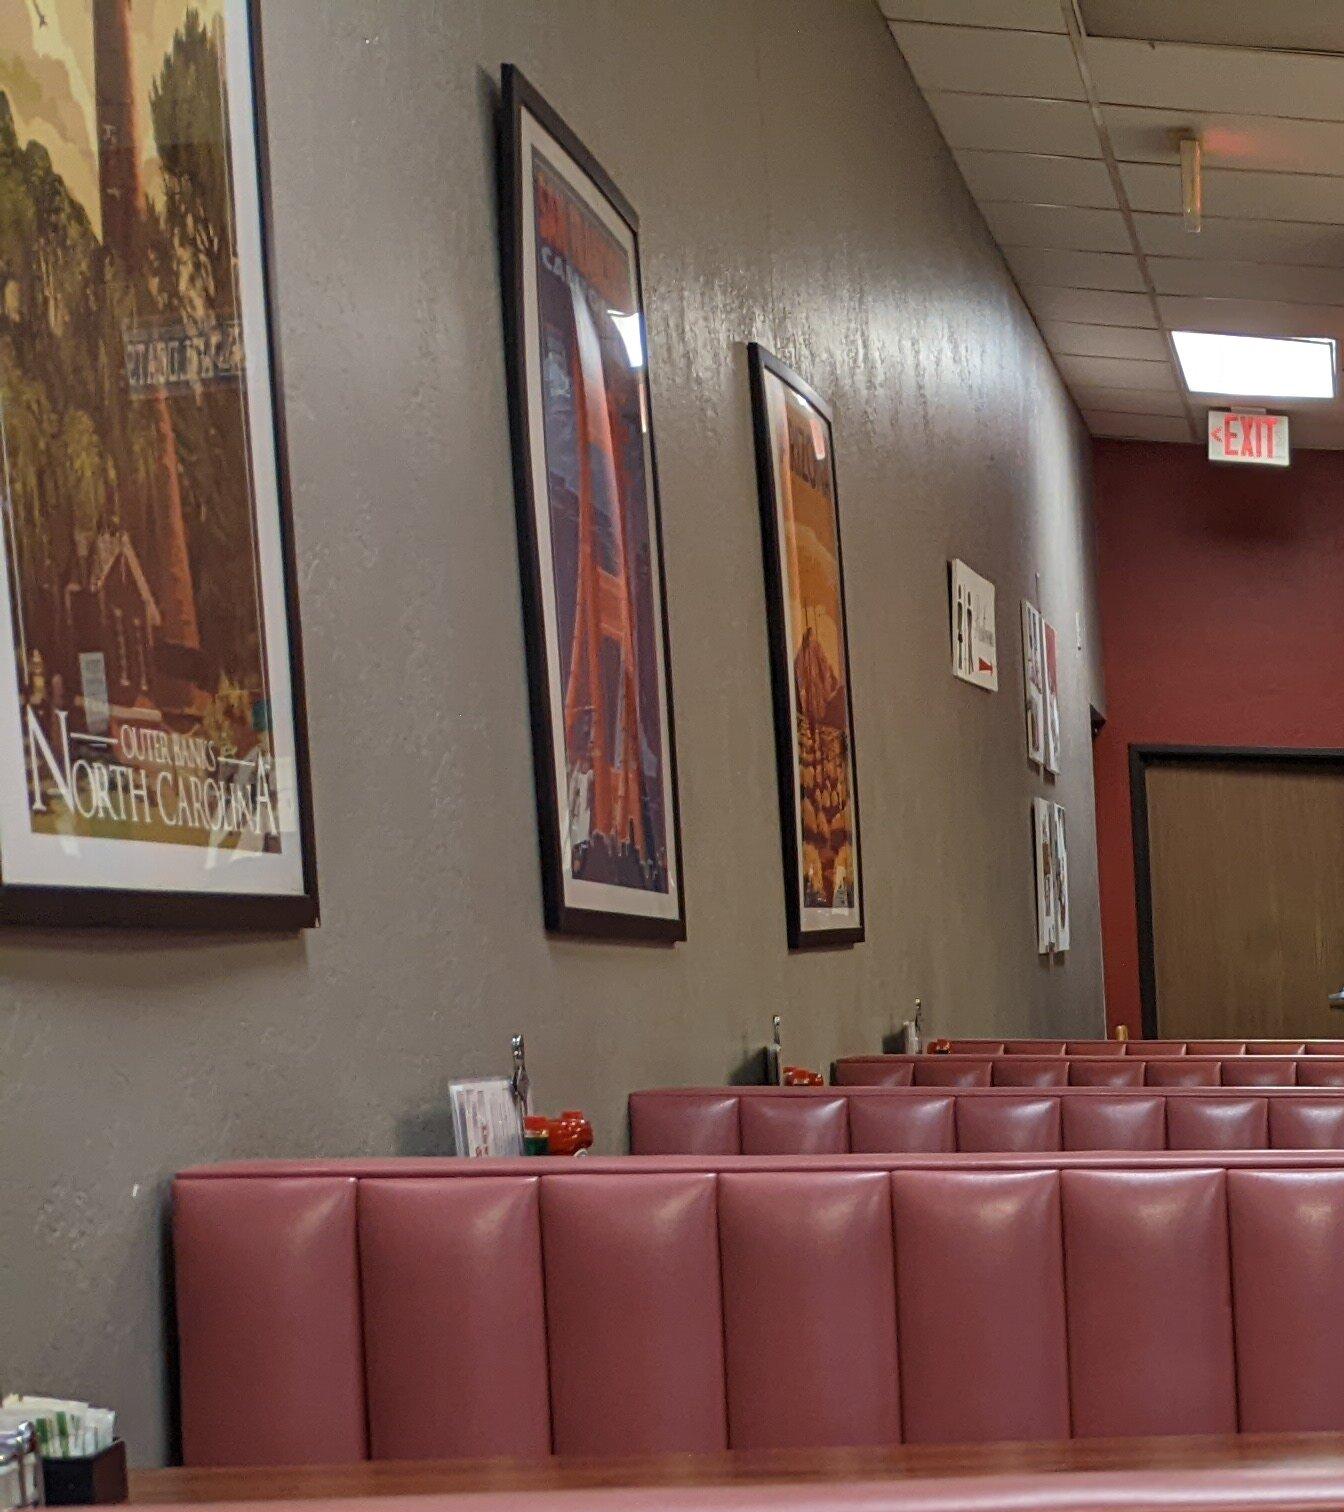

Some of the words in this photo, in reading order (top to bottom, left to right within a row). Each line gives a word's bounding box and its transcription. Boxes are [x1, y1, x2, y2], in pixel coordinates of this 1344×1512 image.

[1224, 413, 1278, 459] EXIT
[26, 703, 152, 824] NORTH
[156, 750, 279, 836] CAROLINA
[120, 724, 170, 763] OUTER
[171, 730, 217, 772] BANKS
